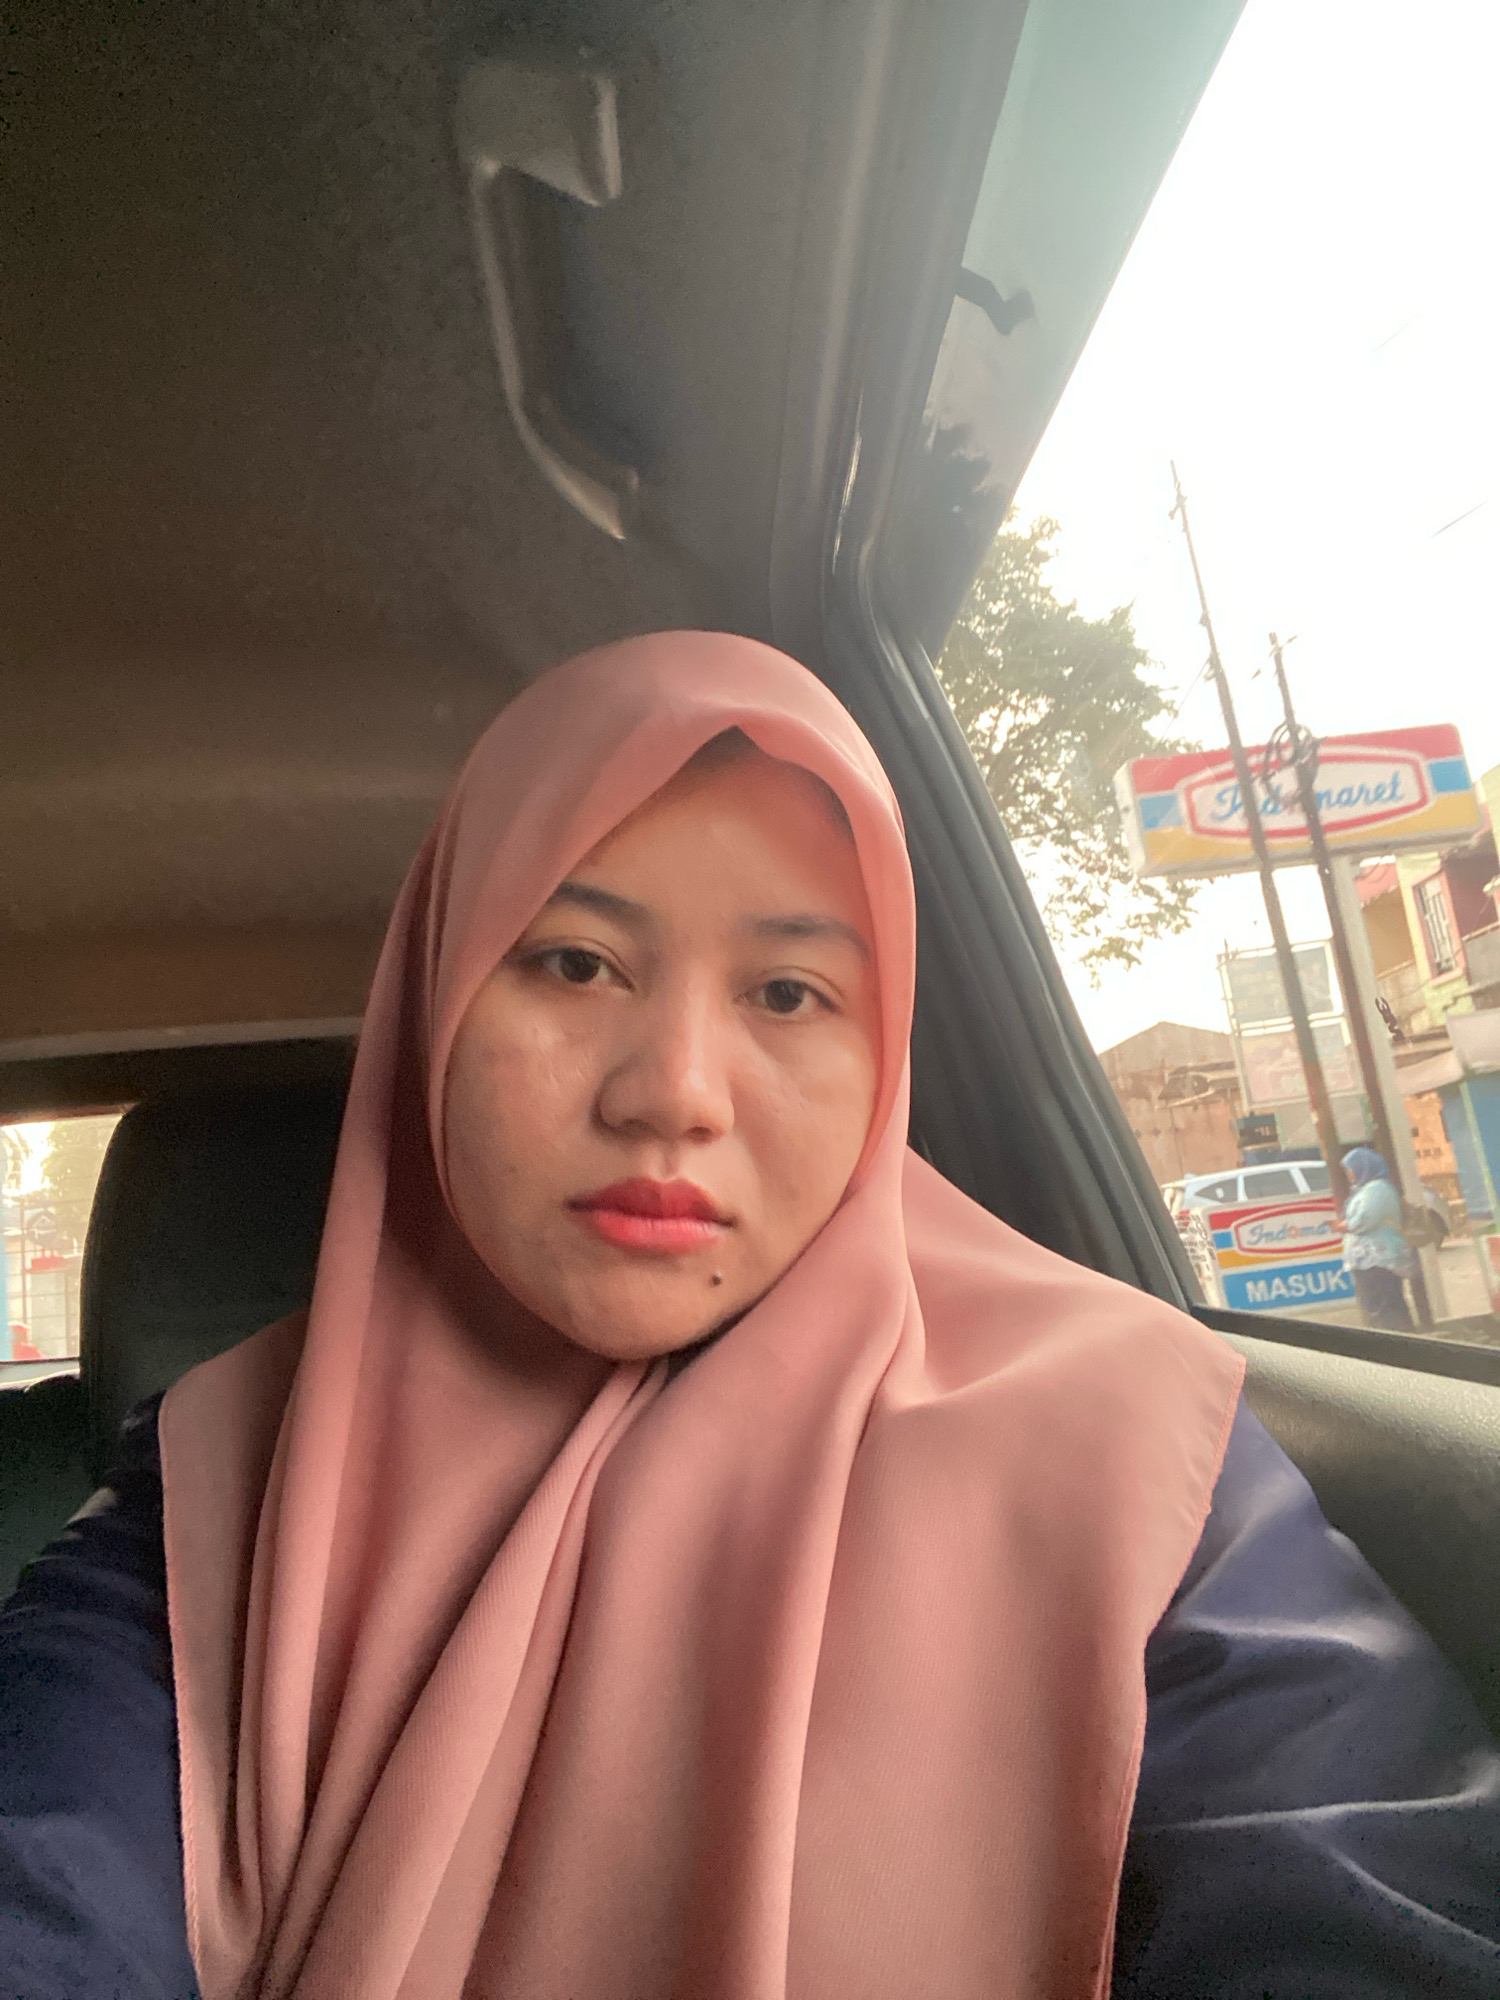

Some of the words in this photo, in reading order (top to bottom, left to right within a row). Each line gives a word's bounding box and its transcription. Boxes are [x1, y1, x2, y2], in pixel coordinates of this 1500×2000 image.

[1211, 771, 1404, 821] Idmaret
[1247, 1223, 1331, 1245] Indoma
[1246, 1268, 1348, 1303] MASUK
